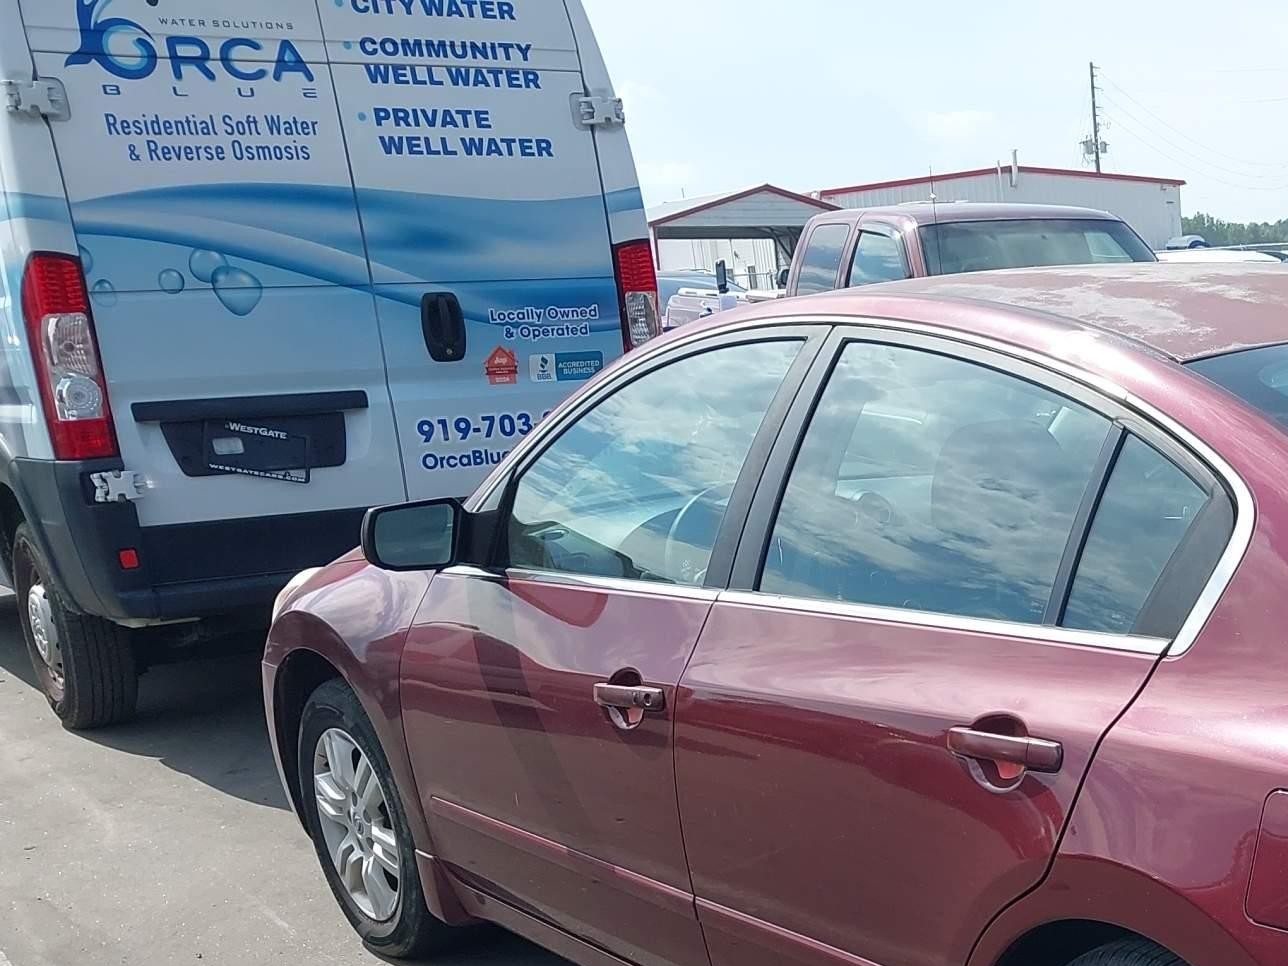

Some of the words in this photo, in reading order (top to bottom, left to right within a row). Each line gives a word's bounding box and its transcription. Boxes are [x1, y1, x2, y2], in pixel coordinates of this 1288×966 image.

[351, 0, 419, 16] CITY
[420, 0, 517, 21] WATER
[158, 17, 207, 28] WATER
[212, 19, 295, 31] SOLUTIONS
[66, 8, 315, 82] ORCA
[359, 37, 532, 62] COMMUNITY
[364, 63, 445, 87] WELL
[445, 66, 542, 90] WATER
[101, 84, 319, 99] BLUE
[104, 112, 219, 136] Residential
[223, 113, 259, 137] Soft
[264, 115, 319, 137] Water
[373, 107, 492, 129] PRIVATE
[128, 143, 142, 162] &
[146, 139, 227, 162] Reverse
[231, 139, 311, 162] Osmosis
[378, 135, 458, 157] WELL
[459, 137, 554, 158] WATER
[489, 306, 543, 324] Locally
[546, 304, 599, 321] Owned
[504, 327, 515, 339] &
[518, 323, 590, 341] Operated
[558, 360, 600, 369] ACCREDITED
[563, 367, 596, 375] BUSINESS
